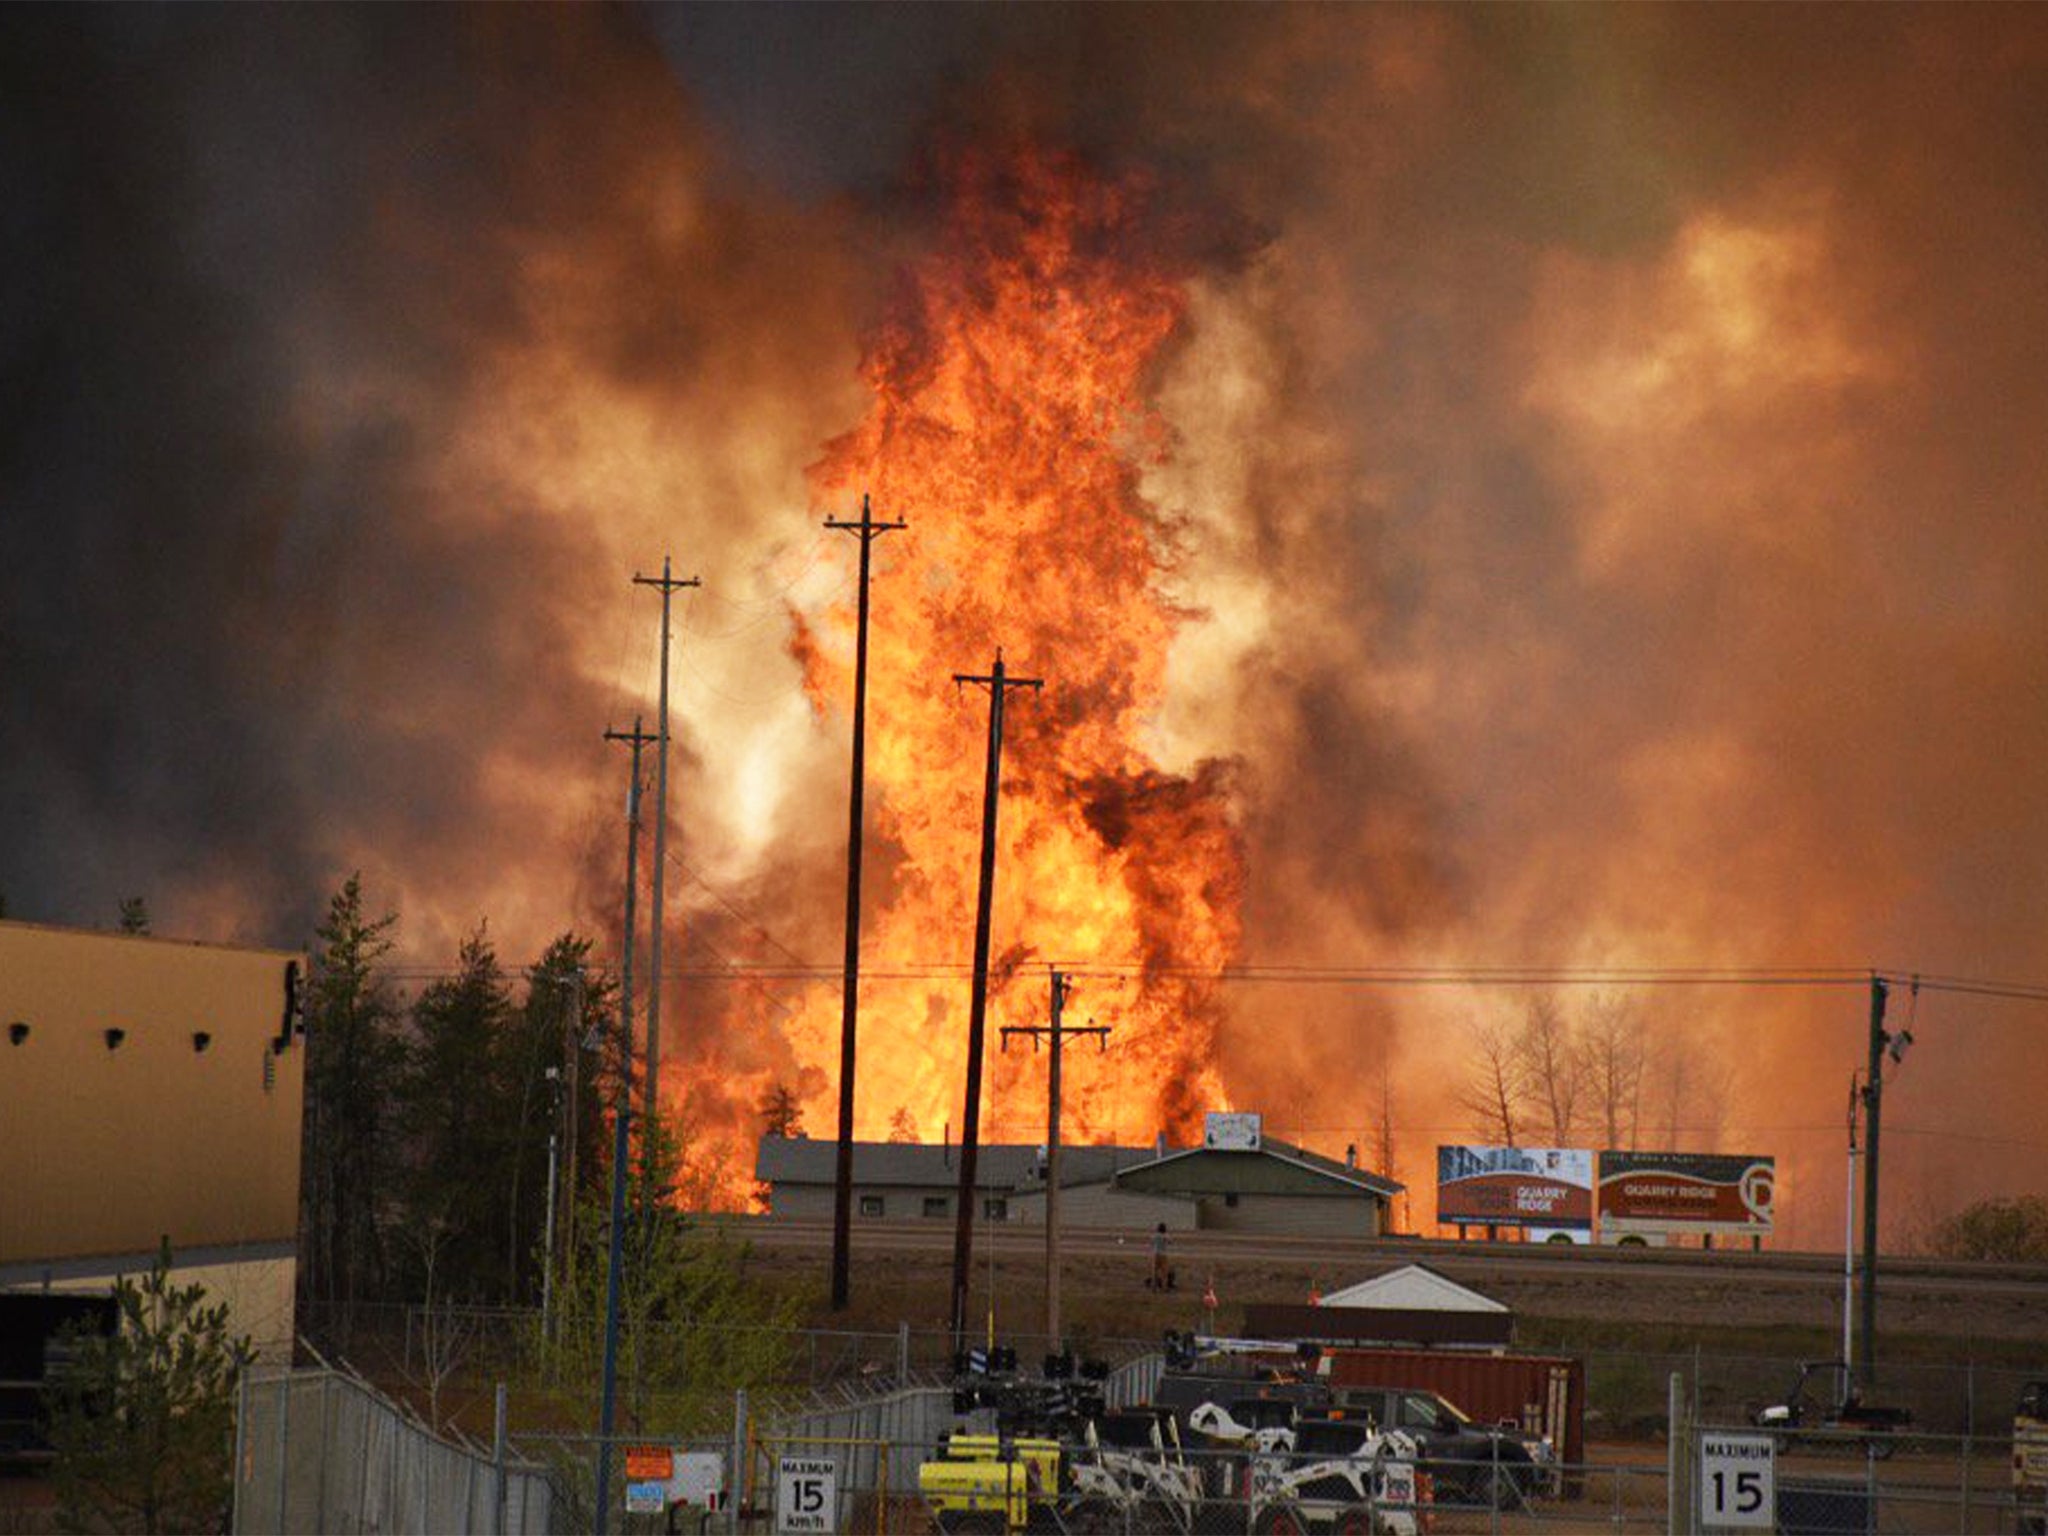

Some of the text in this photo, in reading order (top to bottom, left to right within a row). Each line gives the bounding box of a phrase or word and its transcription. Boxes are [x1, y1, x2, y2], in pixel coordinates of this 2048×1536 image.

[1705, 1443, 1770, 1459] MAXIMUM
[782, 1461, 833, 1475] MAXIMUM
[793, 1480, 824, 1512] 15
[1713, 1471, 1762, 1513] 15
[787, 1513, 824, 1528] km/h
